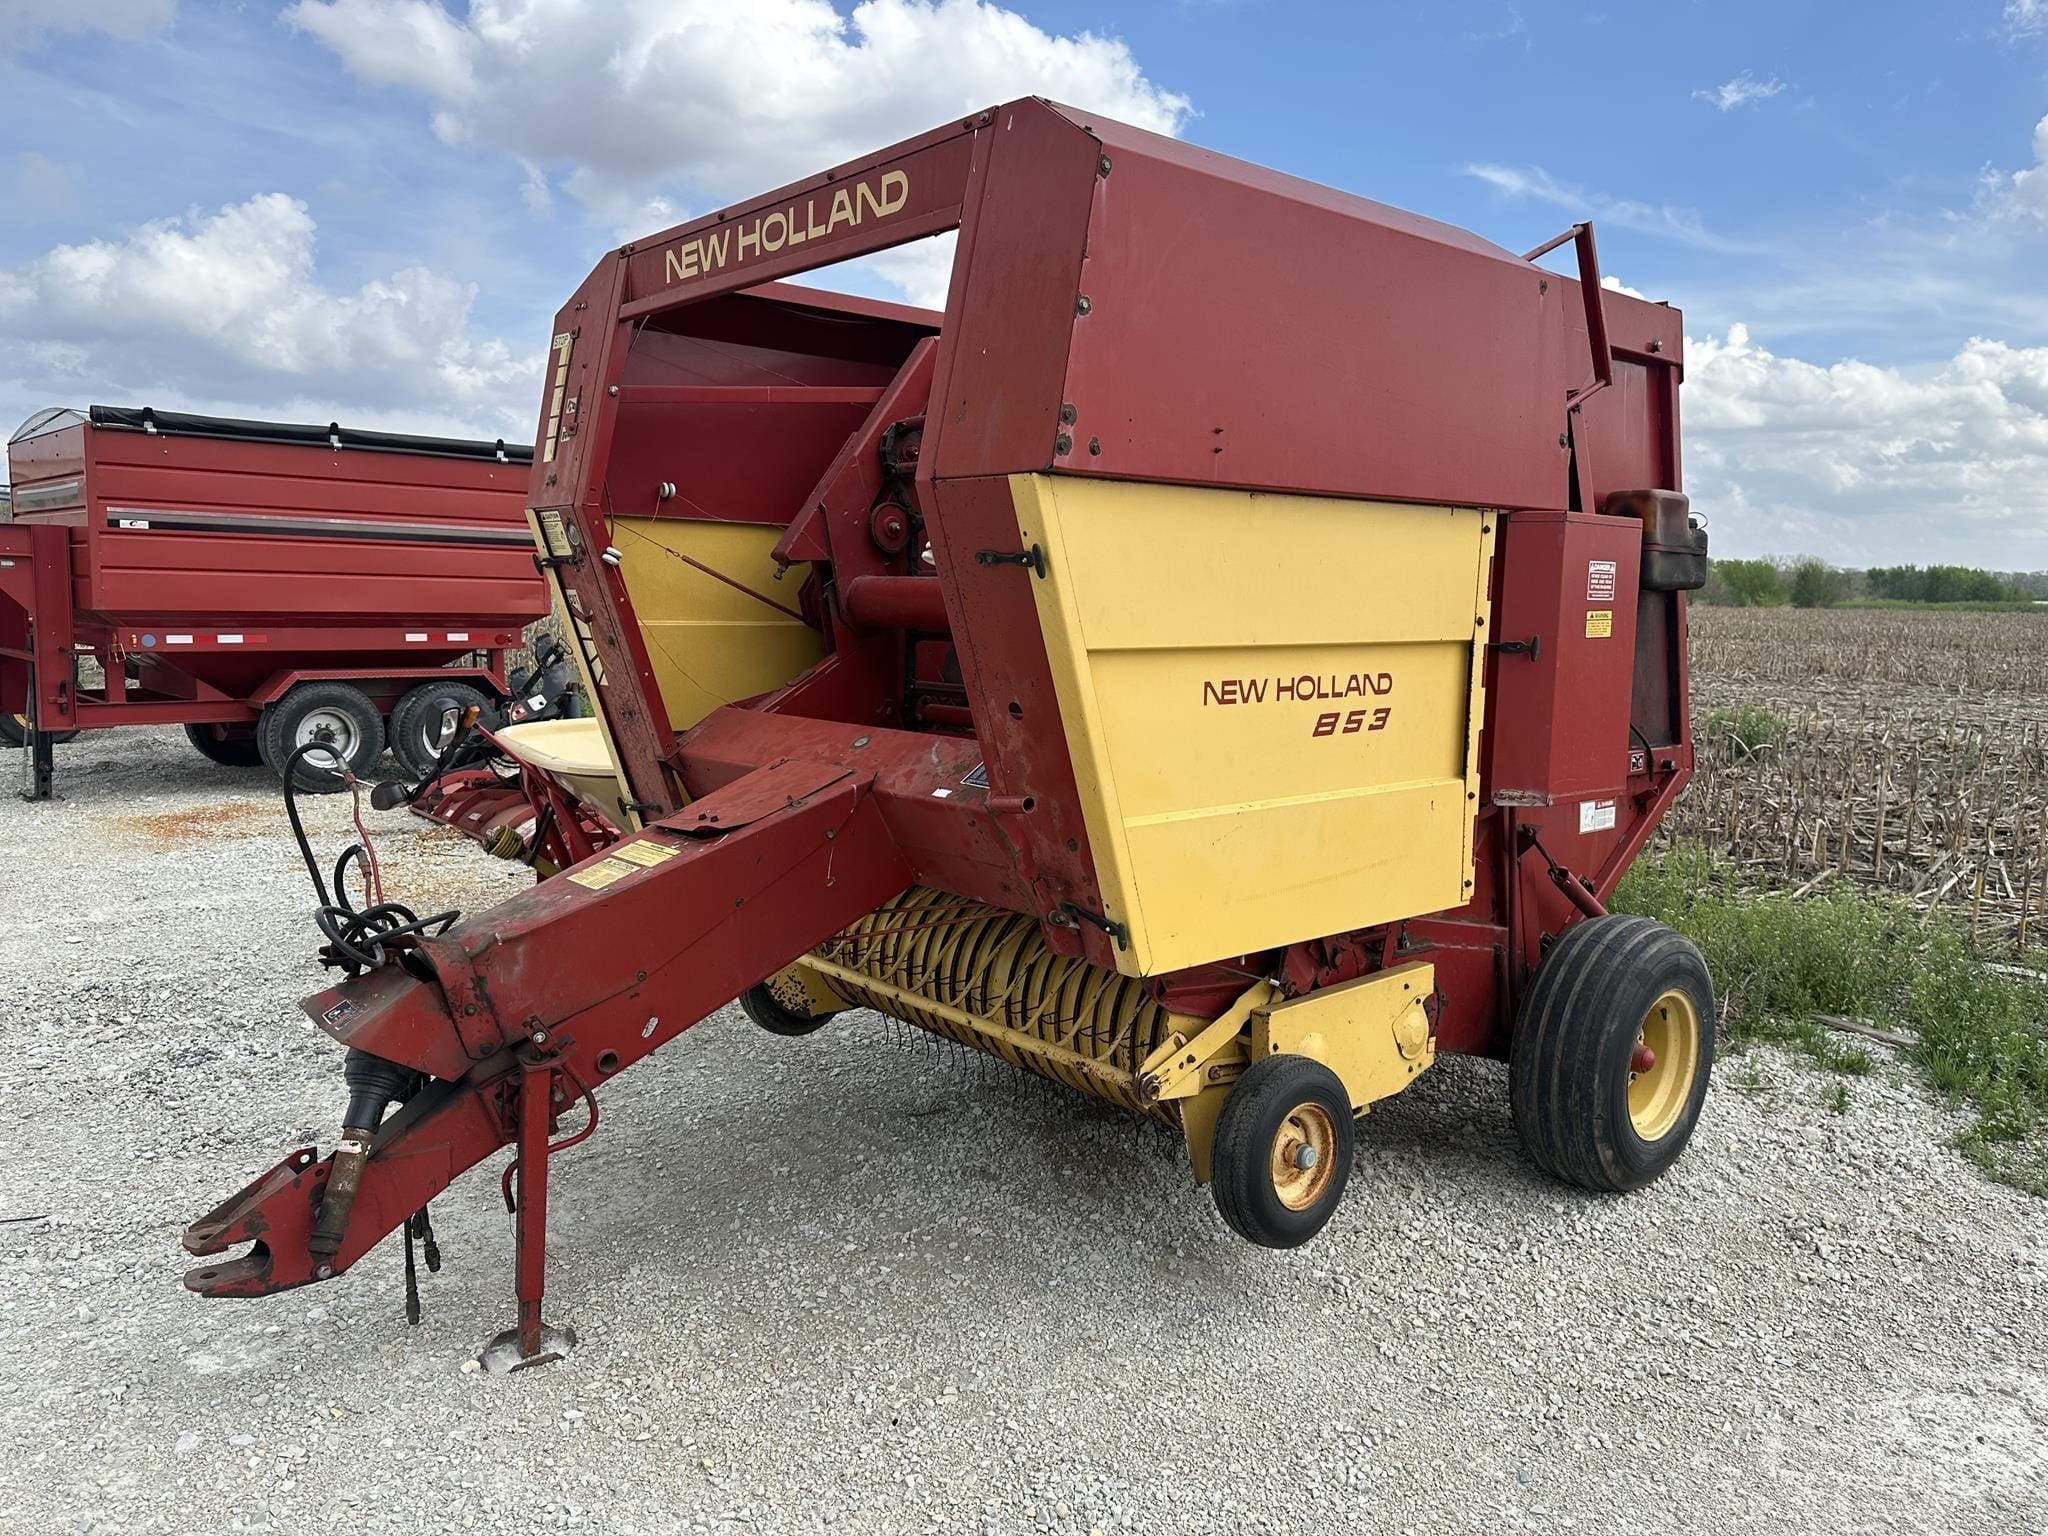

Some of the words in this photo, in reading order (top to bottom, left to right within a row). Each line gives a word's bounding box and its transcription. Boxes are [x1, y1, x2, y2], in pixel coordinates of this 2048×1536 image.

[665, 228, 731, 285] NEW
[738, 169, 909, 262] HOLLAND
[1203, 678, 1269, 706] NEW
[1276, 672, 1393, 702] HOLLAND
[1312, 707, 1392, 738] 853
